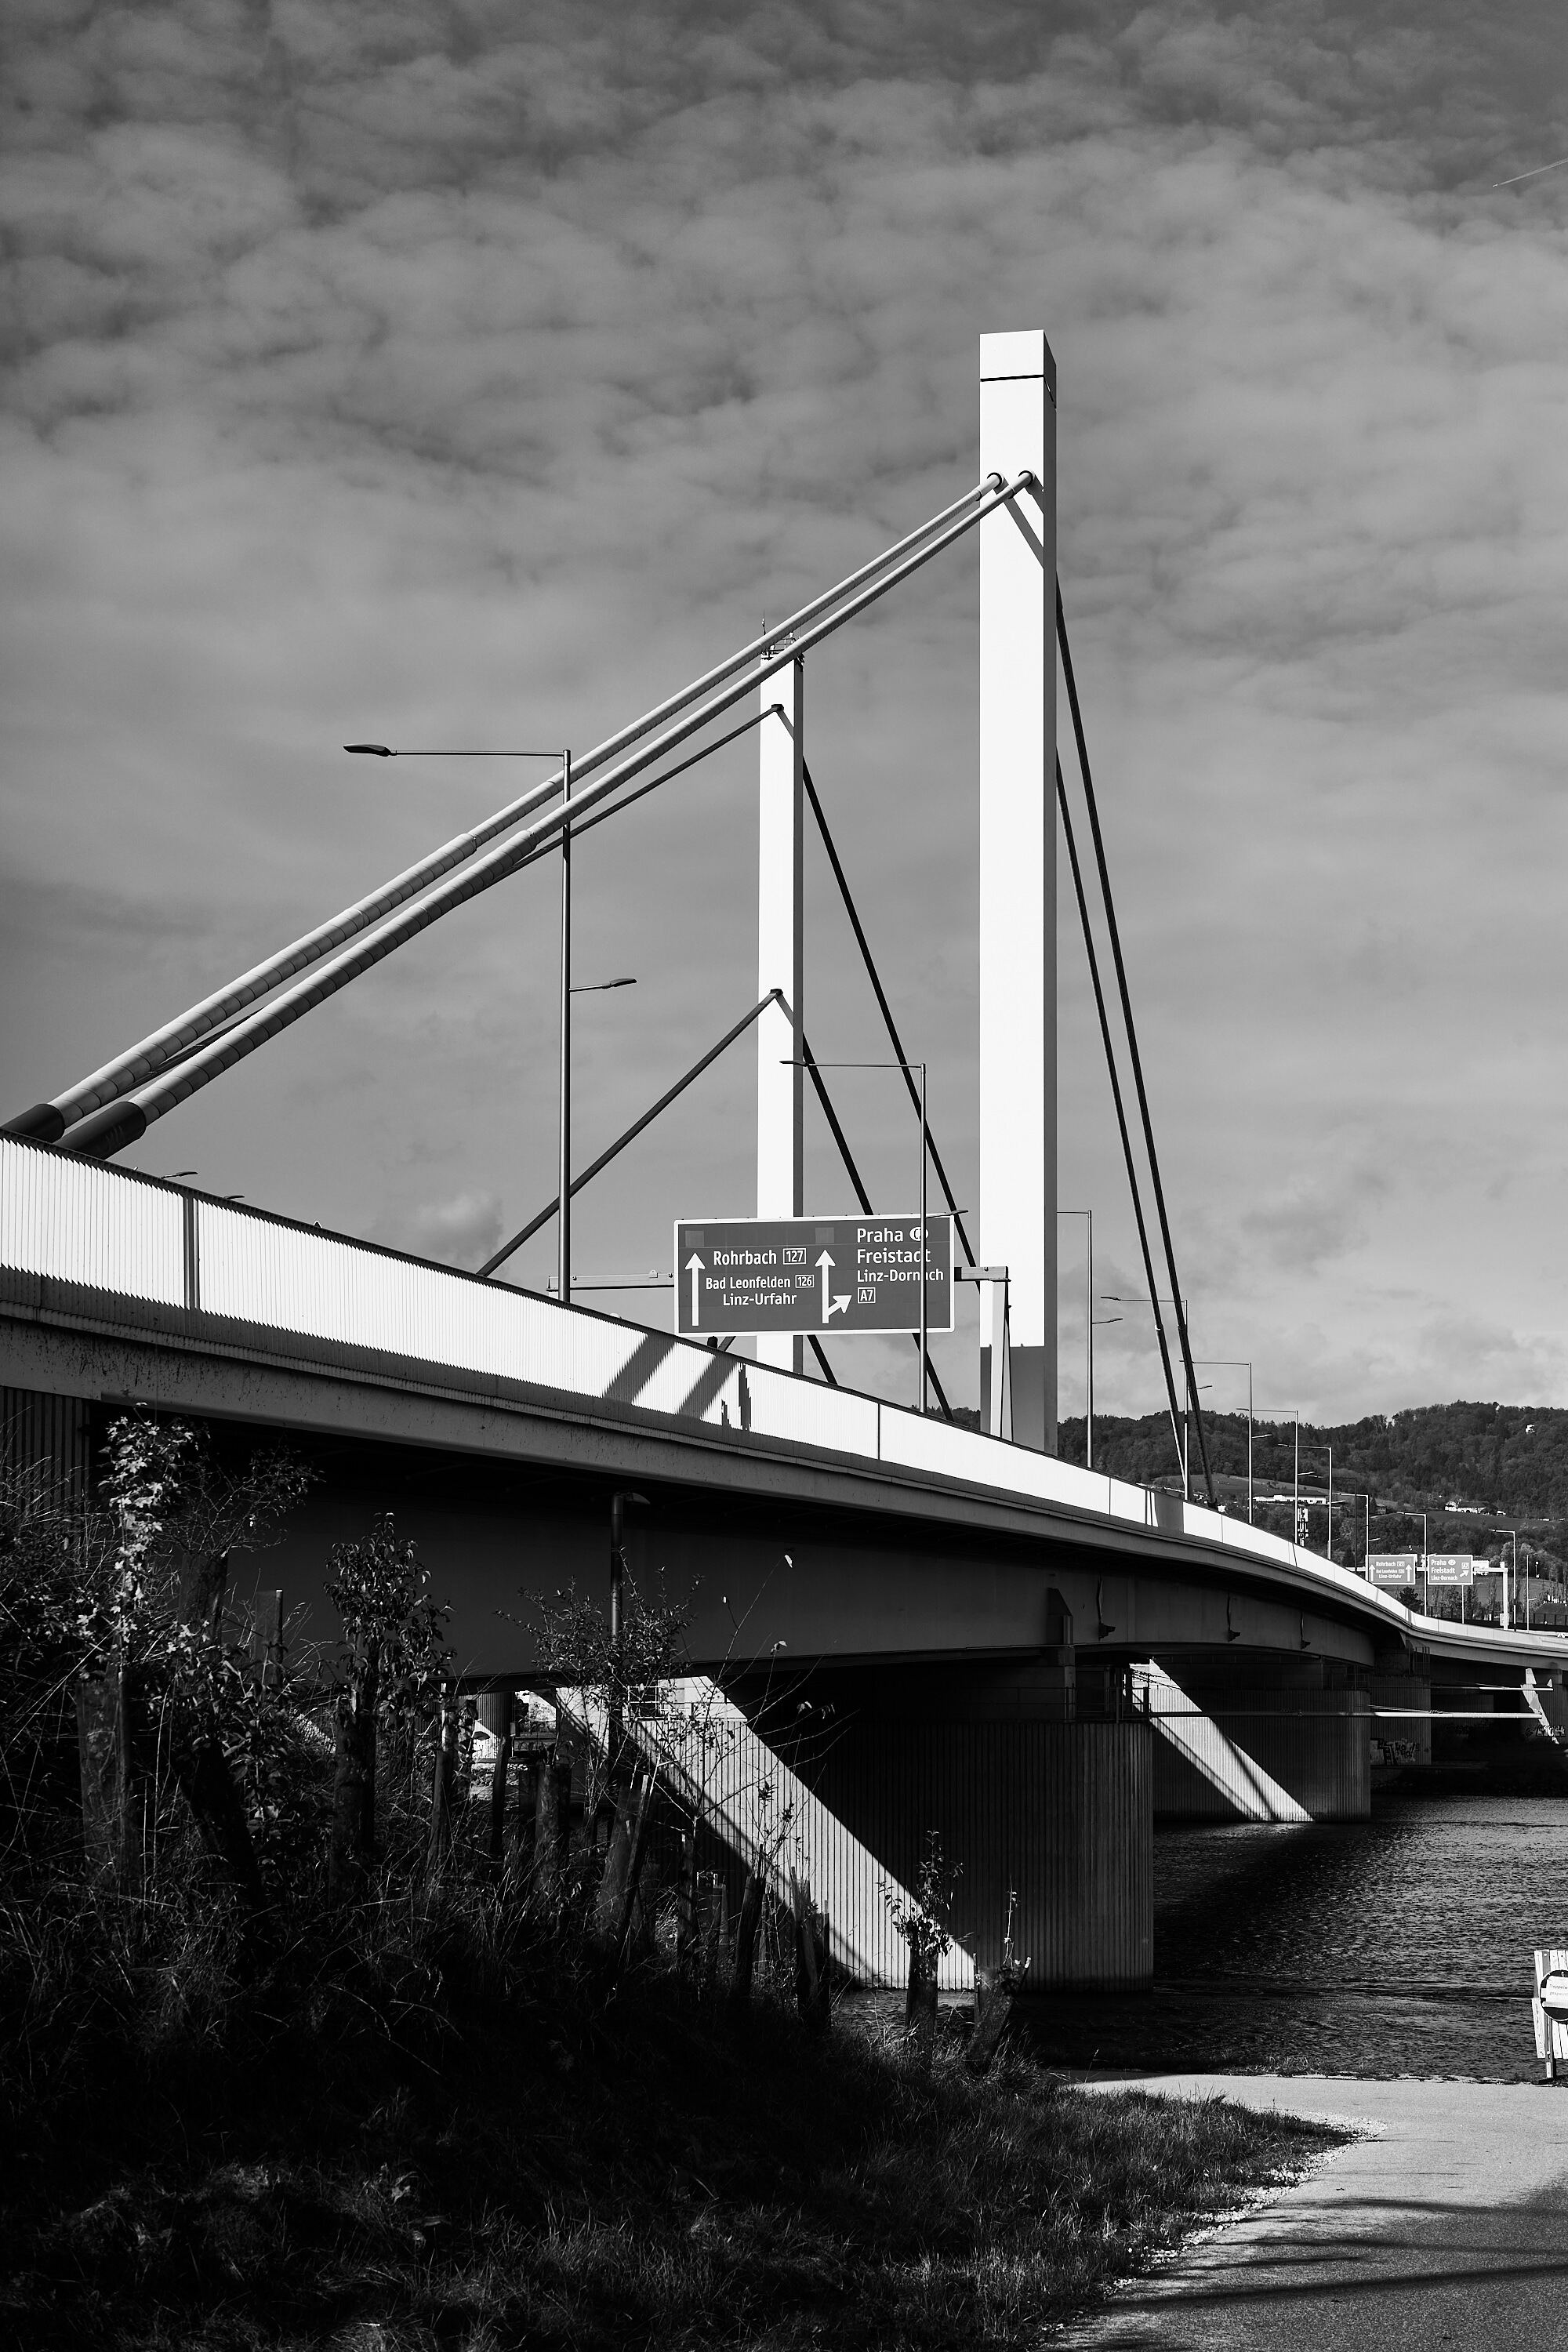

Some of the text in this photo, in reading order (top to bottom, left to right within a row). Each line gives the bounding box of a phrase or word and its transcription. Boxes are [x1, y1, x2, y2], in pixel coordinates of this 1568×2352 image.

[857, 1227, 904, 1243] Praha
[713, 1249, 804, 1265] Rohrbach 127
[857, 1247, 931, 1264] Freistadt
[706, 1276, 812, 1290] Bad Leonfelden 126
[723, 1292, 797, 1306] Linz-Urfahr
[859, 1289, 873, 1301] A7
